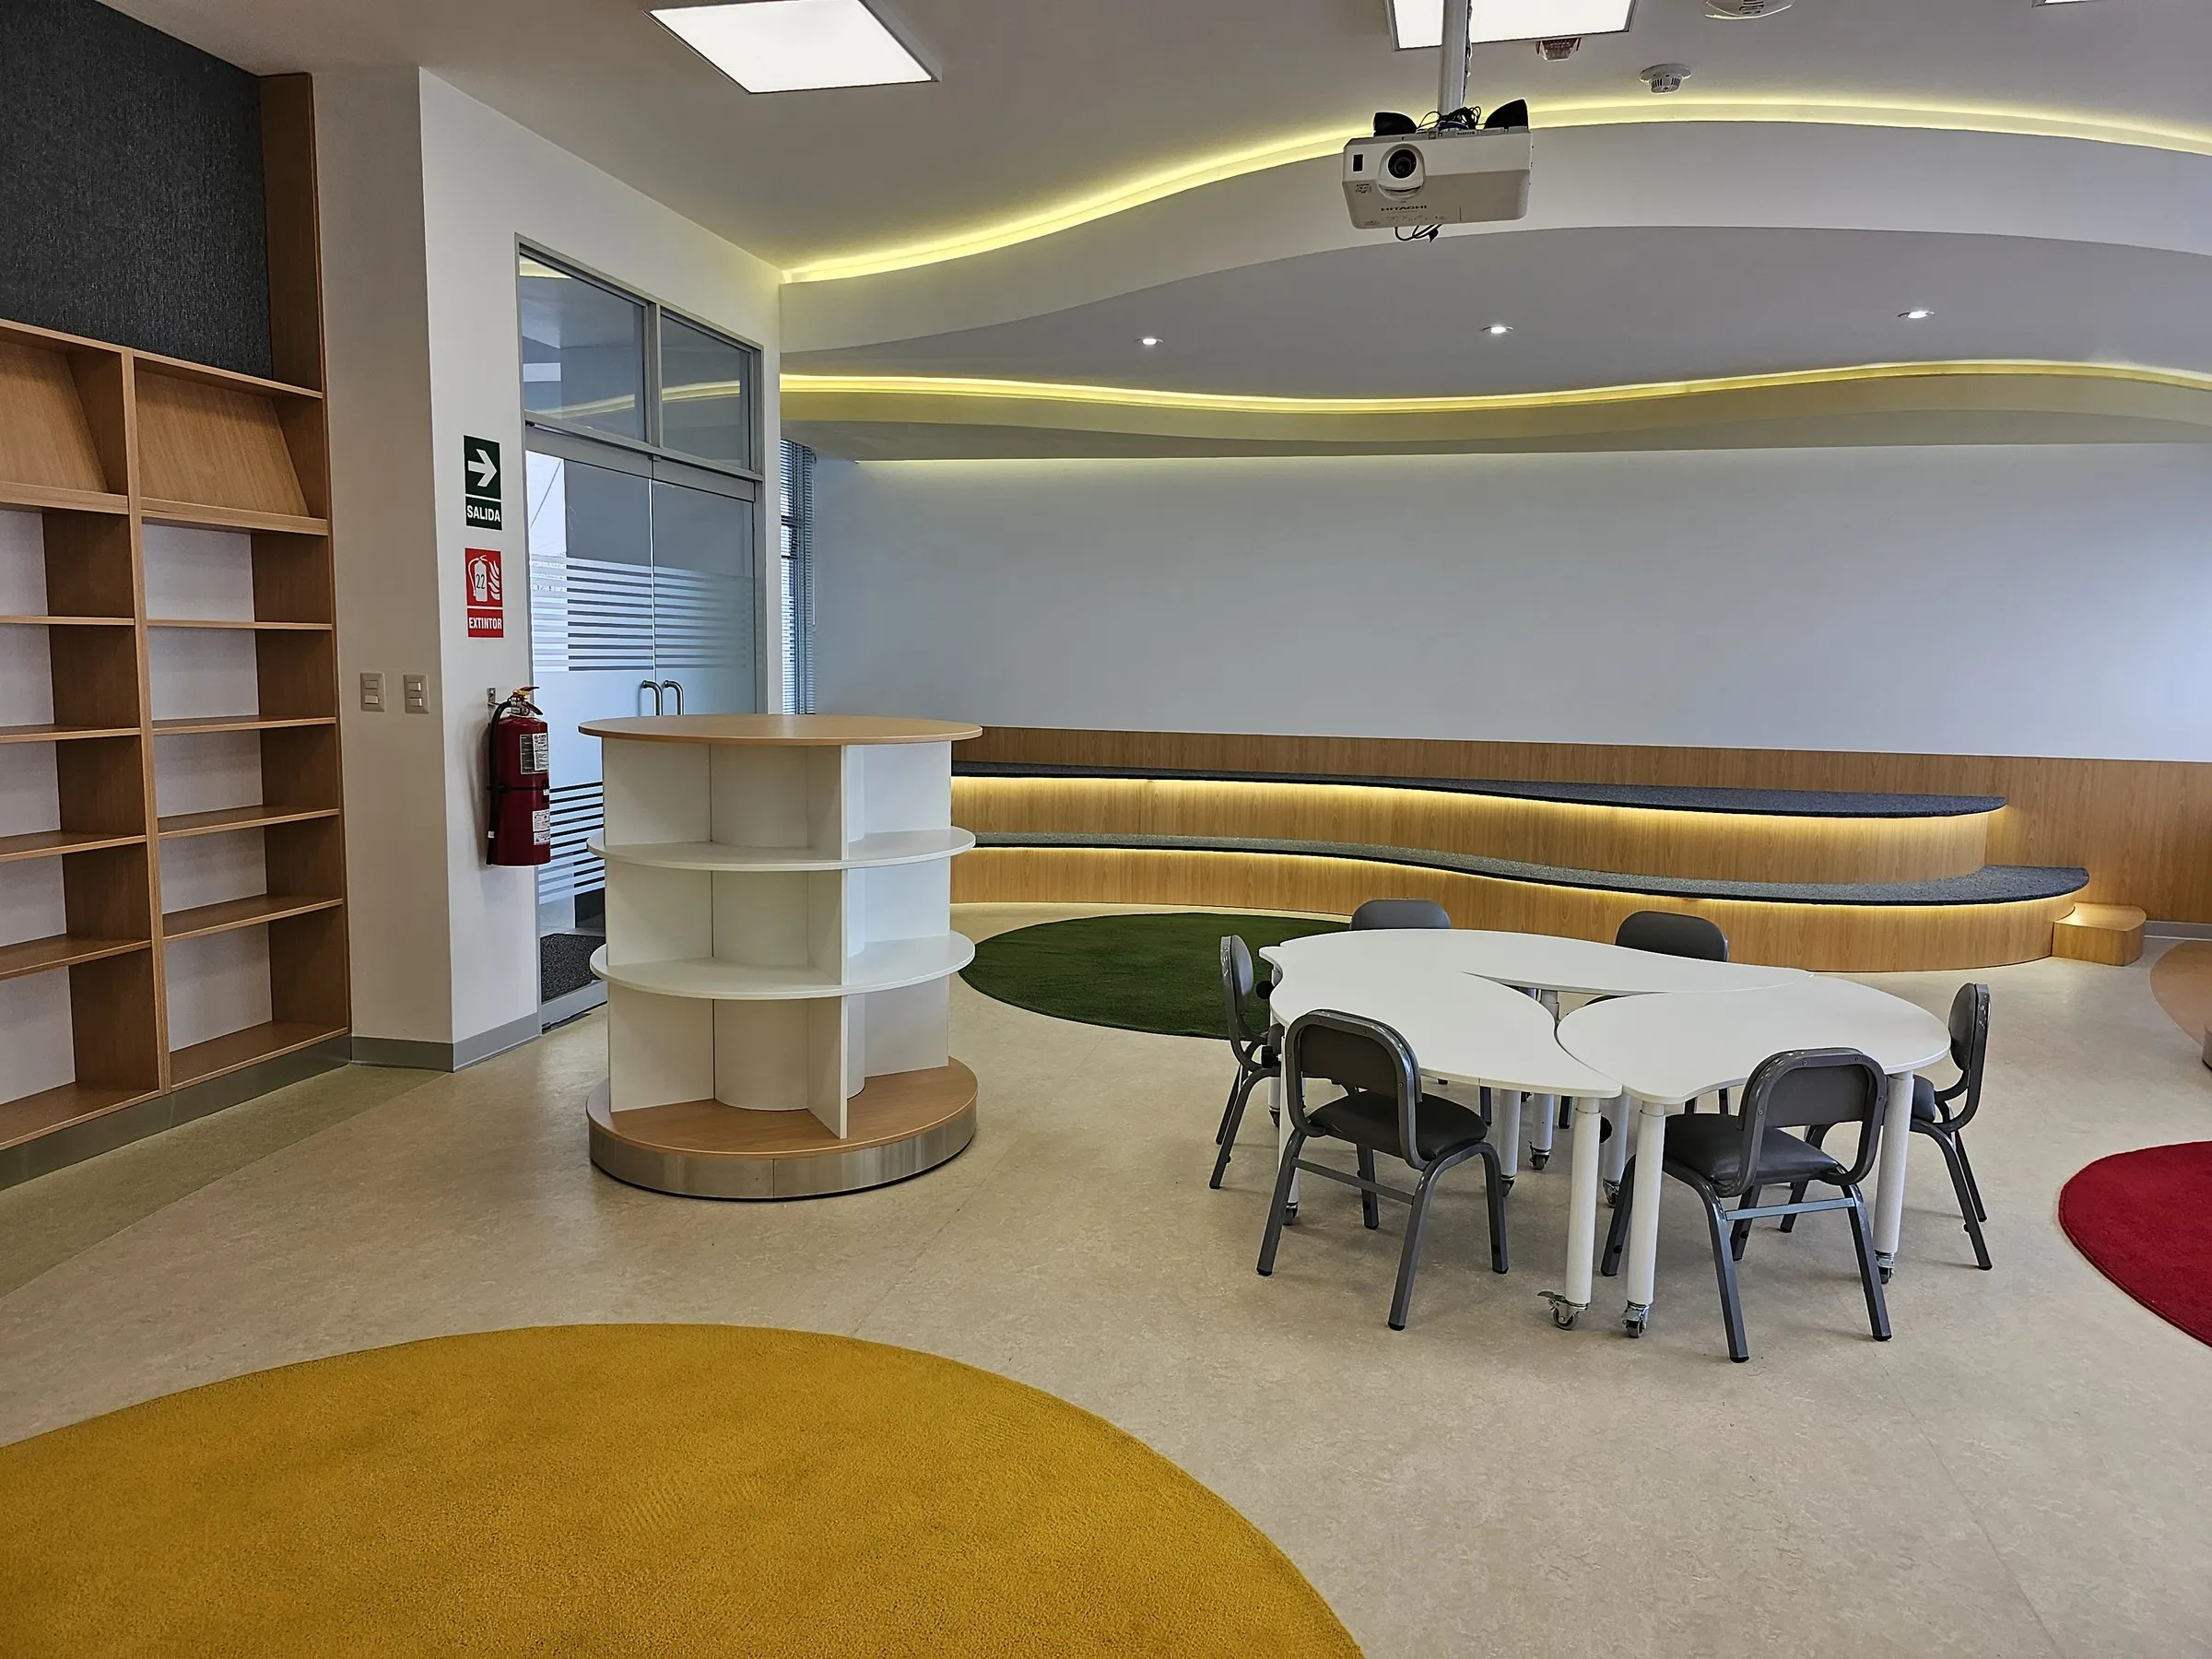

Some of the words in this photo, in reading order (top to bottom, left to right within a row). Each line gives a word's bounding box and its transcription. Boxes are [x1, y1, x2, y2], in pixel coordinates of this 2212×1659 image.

[466, 505, 500, 522] SALIDA
[476, 573, 486, 589] 22
[468, 617, 502, 629] EXTINTOR
